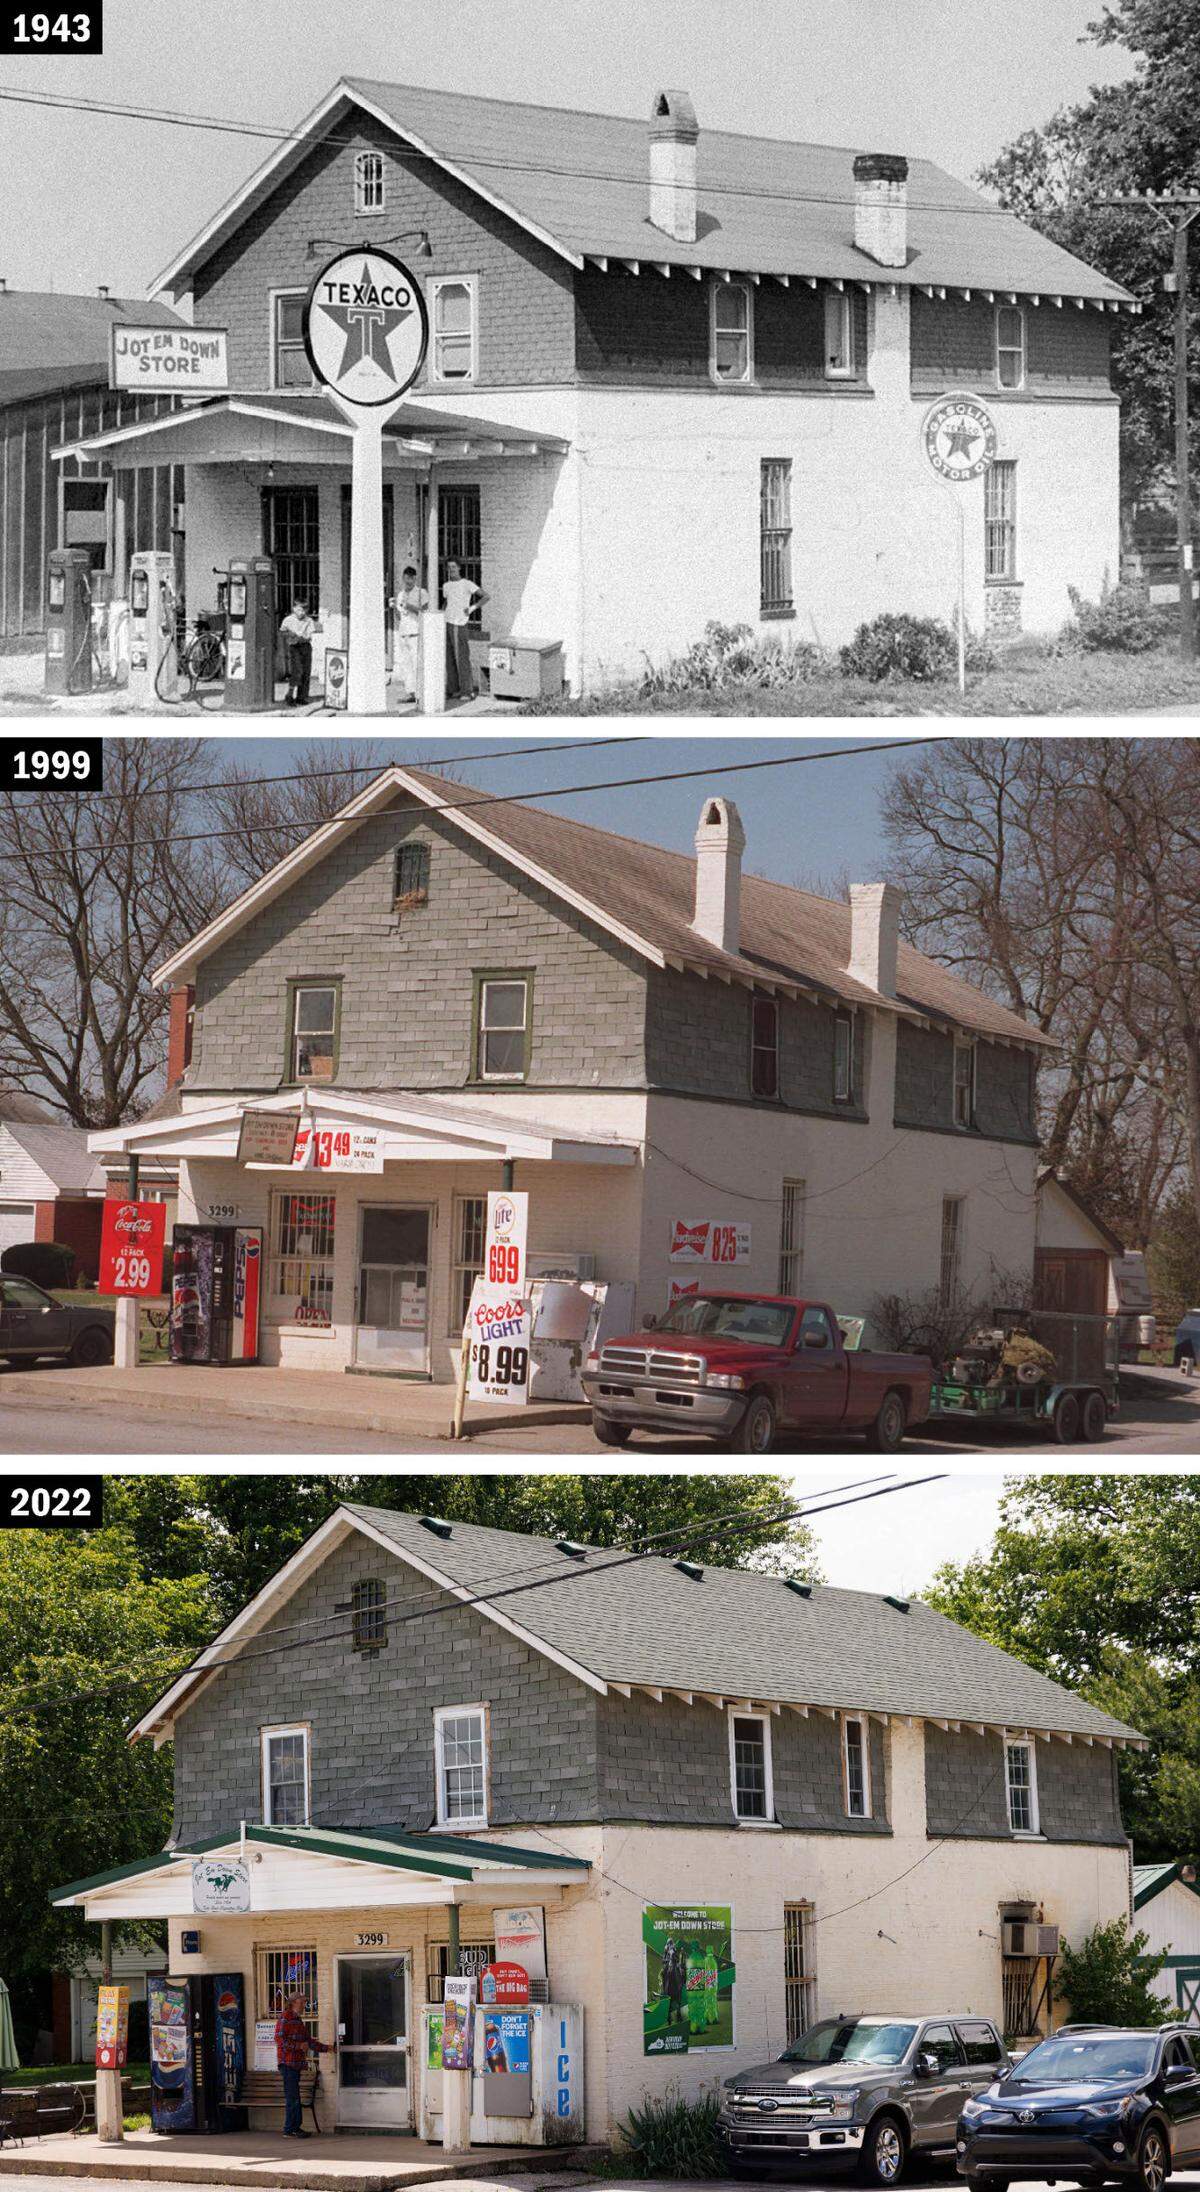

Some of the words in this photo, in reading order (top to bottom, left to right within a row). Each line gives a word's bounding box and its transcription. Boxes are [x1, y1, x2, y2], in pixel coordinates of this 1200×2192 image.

[323, 281, 411, 307] TEXACO
[116, 337, 150, 356] JOT
[154, 334, 173, 350] EM
[180, 335, 219, 358] DOWN
[139, 355, 200, 373] STORE
[930, 404, 994, 438] GASOLINE
[928, 445, 971, 479] MOTOR
[974, 450, 994, 472] OIL
[208, 1205, 234, 1216] 3299
[494, 1208, 512, 1230] Lite
[115, 1218, 152, 1232] Coca-Cola
[712, 1226, 736, 1262] 825
[490, 1245, 519, 1285] 699
[235, 1242, 245, 1319] PEPSI
[475, 1300, 525, 1326] Coors
[481, 1319, 522, 1342] LIGHT
[472, 1344, 528, 1385] $8.99
[492, 1387, 509, 1396] PACK
[653, 1920, 680, 1930] JOT-EM
[681, 1920, 702, 1930] DOWN
[703, 1920, 725, 1930] STORE
[358, 1933, 383, 1946] 3299
[496, 1984, 505, 1993] THE
[506, 1982, 516, 1993] BIG
[516, 1983, 528, 1993] BAG
[501, 2015, 522, 2023] DON'T
